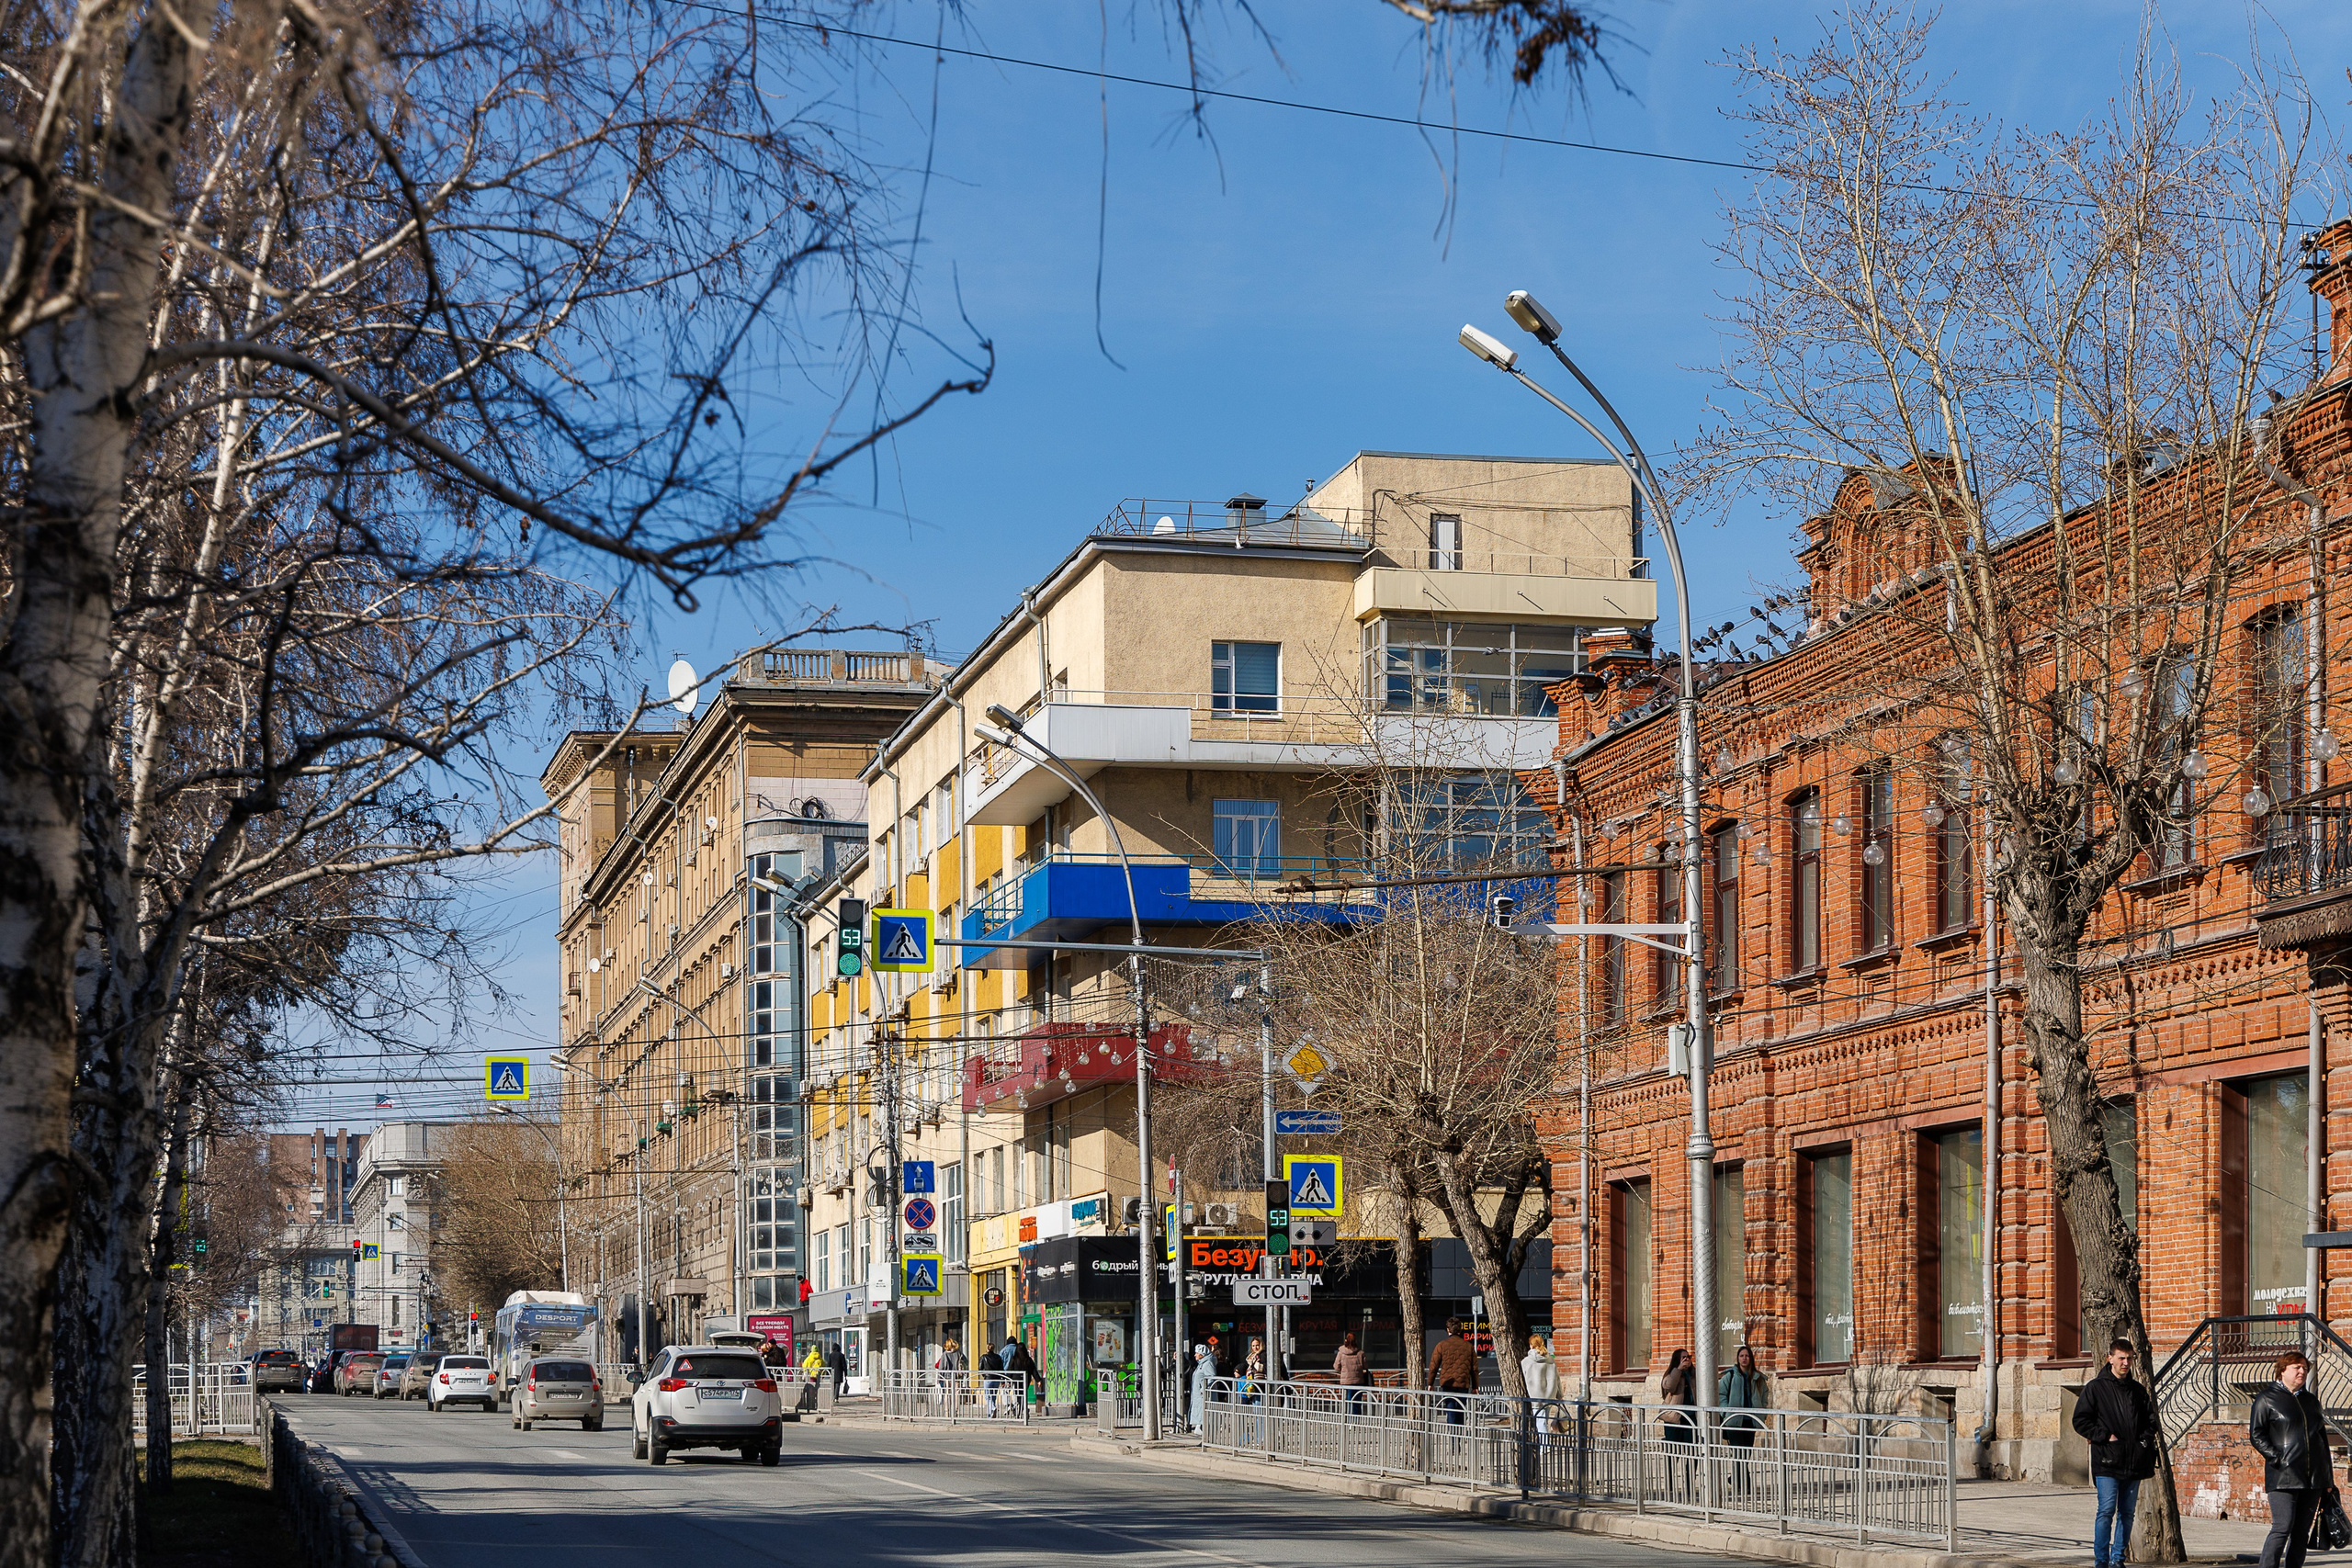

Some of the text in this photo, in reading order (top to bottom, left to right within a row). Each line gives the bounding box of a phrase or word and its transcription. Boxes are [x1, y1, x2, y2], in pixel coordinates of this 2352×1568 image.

[842, 929, 861, 946] 53
[1270, 1210, 1287, 1226] 53
[1192, 1243, 1324, 1271] Безуо.
[1201, 1273, 1248, 1286] РУТАЯ
[1248, 1285, 1298, 1300] СТОП
[1299, 1320, 1338, 1330] КРУТАЯ
[1349, 1321, 1396, 1330] ШАУРМА
